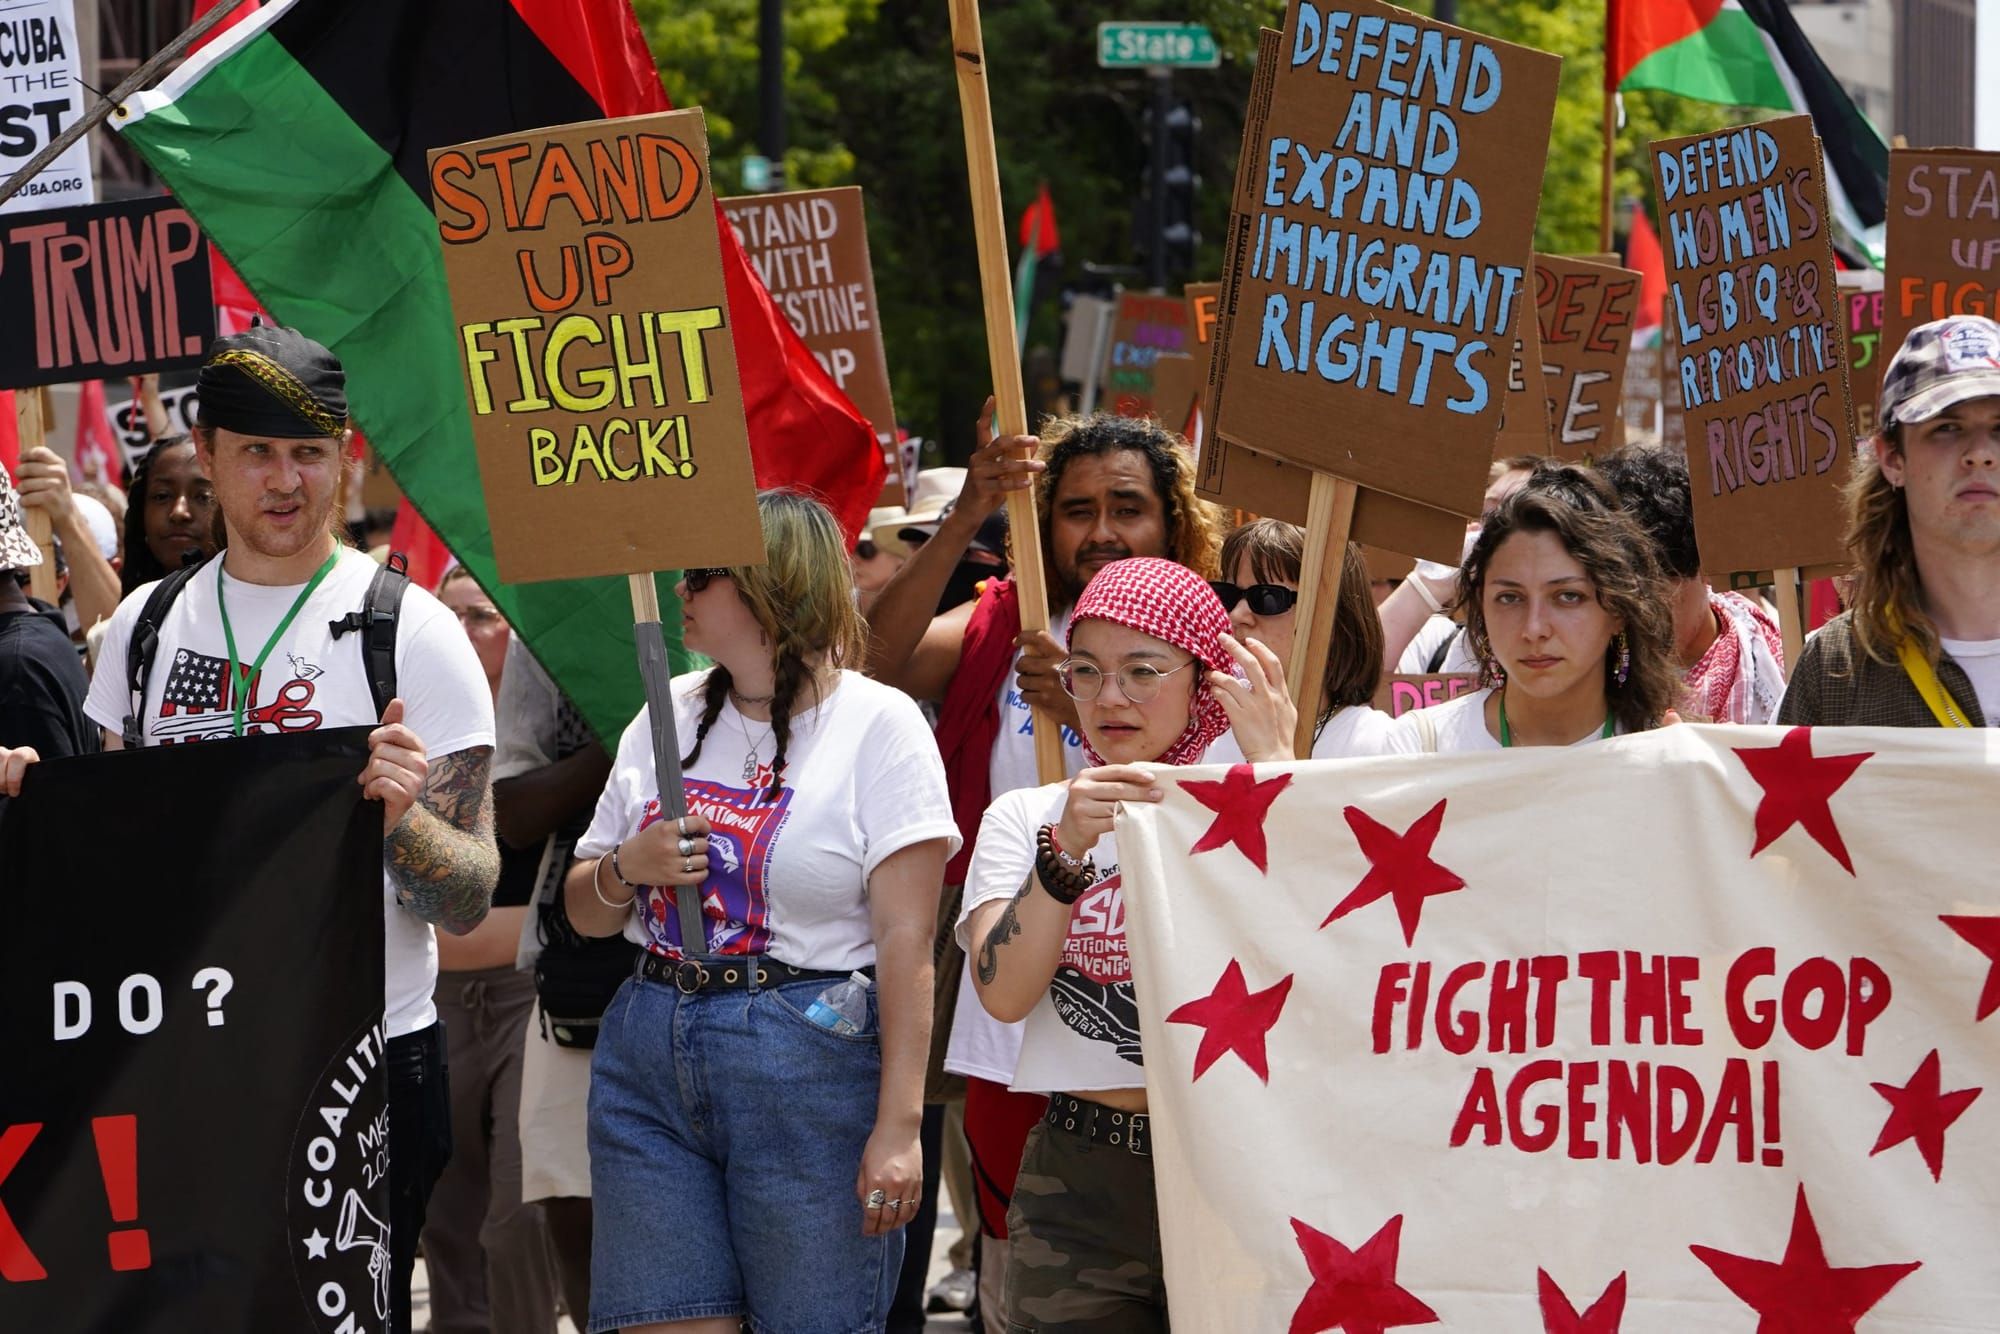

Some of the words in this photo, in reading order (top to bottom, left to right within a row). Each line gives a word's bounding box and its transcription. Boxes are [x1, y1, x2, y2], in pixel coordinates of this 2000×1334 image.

[3, 69, 70, 93] THE
[1117, 29, 1194, 60] State
[1291, 1, 1502, 115] DEFEND
[1333, 90, 1459, 176] AND
[1657, 127, 1780, 206] DEFEND
[431, 133, 702, 244] STAND
[1263, 136, 1482, 239] EXPAND
[1668, 166, 1819, 270] WOMEN'S
[516, 231, 634, 313] UP
[1249, 212, 1522, 336] IMMIGRANT
[462, 306, 726, 415] FIGHT
[1255, 292, 1490, 415] RIGHTS
[527, 414, 698, 487] BACK!
[1705, 382, 1839, 497] RIGHTS
[1373, 955, 1568, 1055] FIGHT
[1577, 950, 1703, 1047] THE
[1725, 946, 1892, 1057] GOP
[1449, 1057, 1784, 1168] AGENDA!
